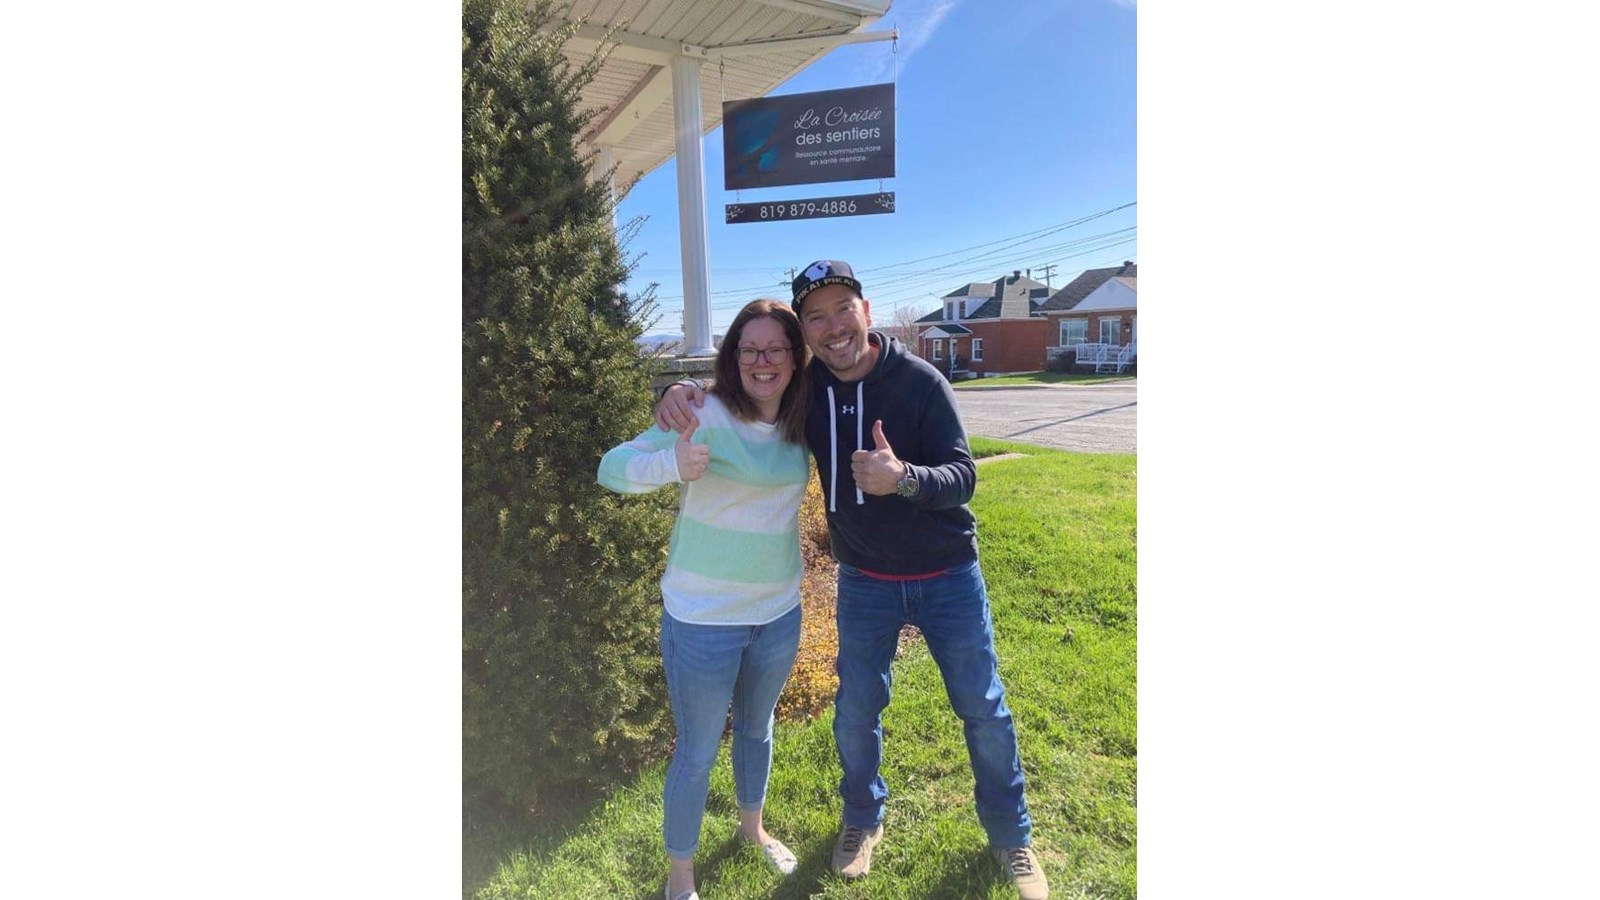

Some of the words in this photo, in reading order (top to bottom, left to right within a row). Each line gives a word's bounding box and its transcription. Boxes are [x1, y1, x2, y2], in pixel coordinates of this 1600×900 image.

[794, 108, 821, 130] La
[825, 106, 882, 126] Croisée
[796, 132, 822, 146] des
[826, 126, 881, 143] sentiers
[795, 150, 827, 159] Ressource
[829, 145, 881, 156] communautaire
[839, 155, 867, 164] mentale
[760, 205, 785, 219] 819
[790, 200, 857, 217] 879-4886
